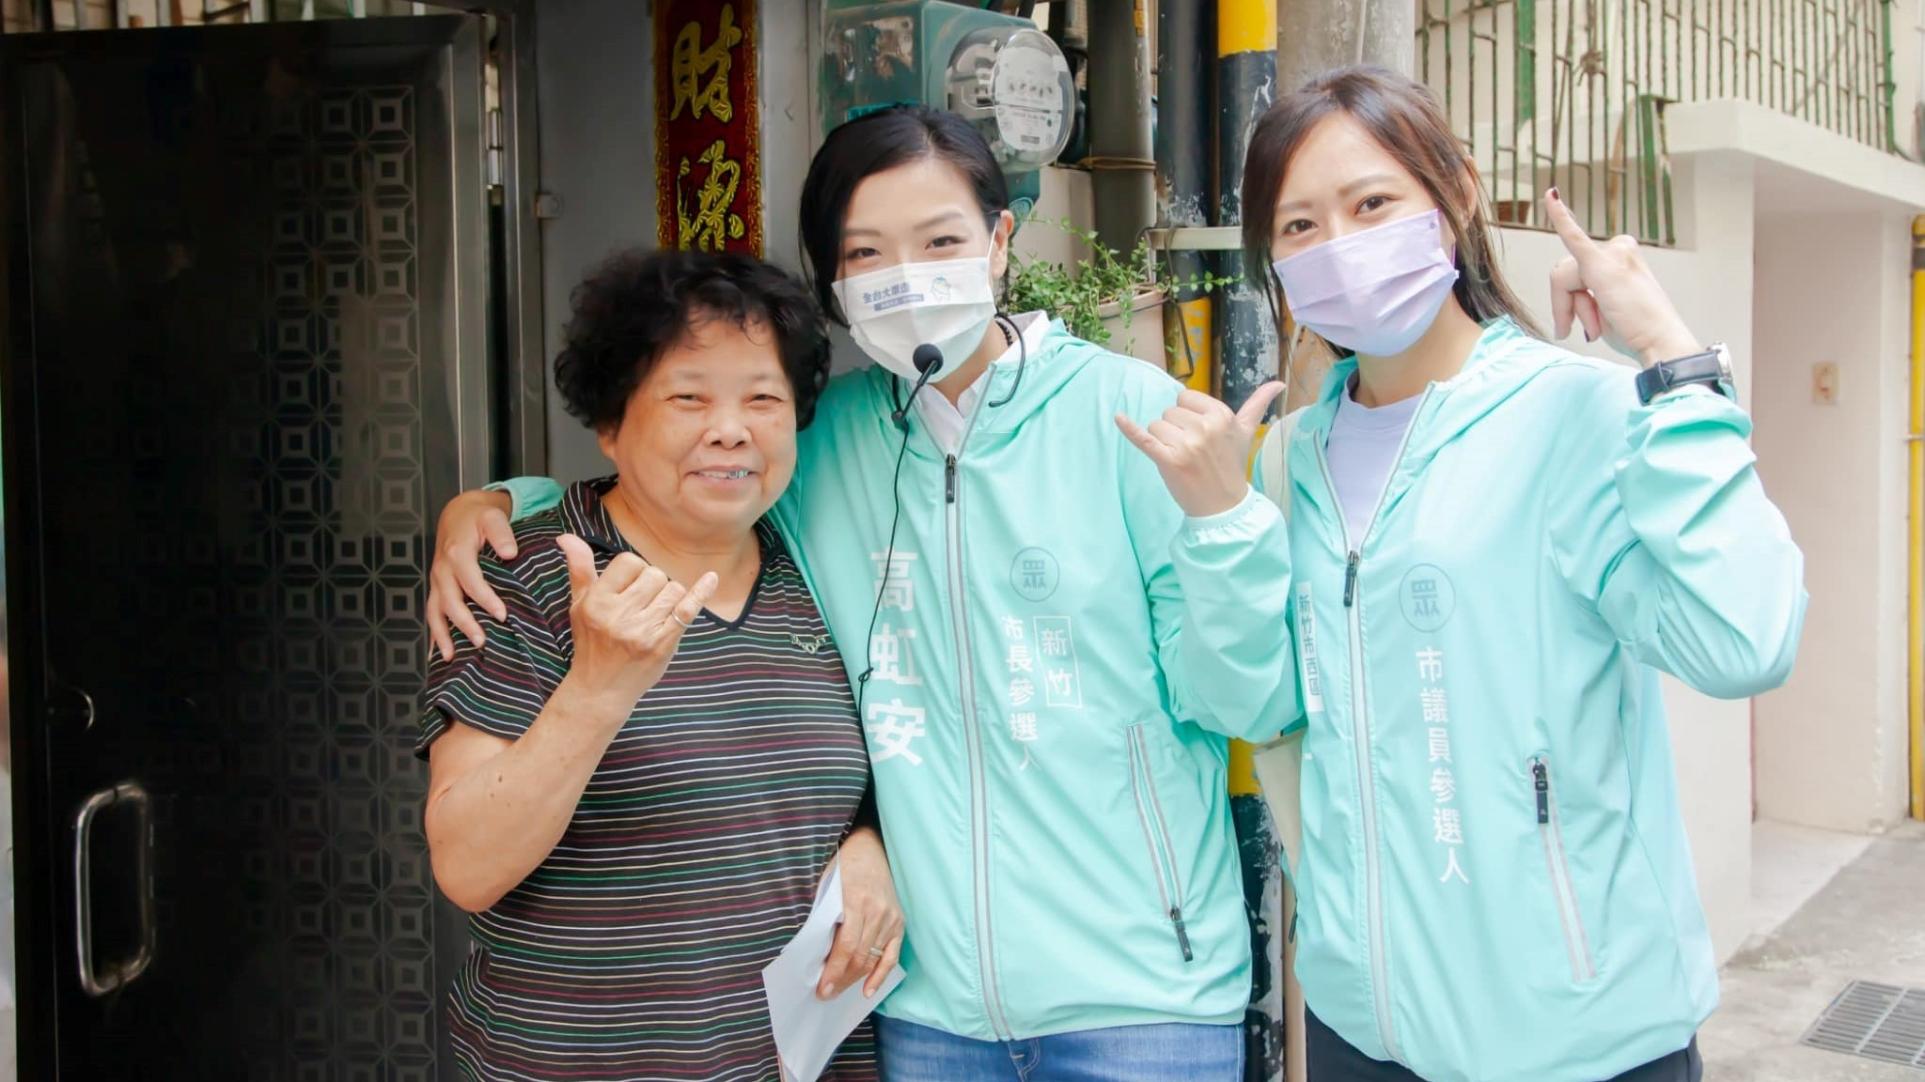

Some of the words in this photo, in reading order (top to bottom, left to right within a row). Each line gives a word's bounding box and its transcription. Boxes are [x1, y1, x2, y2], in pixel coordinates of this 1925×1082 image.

[866, 545, 926, 767] 高虹安
[1040, 628, 1073, 696] 新竹
[1416, 646, 1470, 885] 市議員參選人
